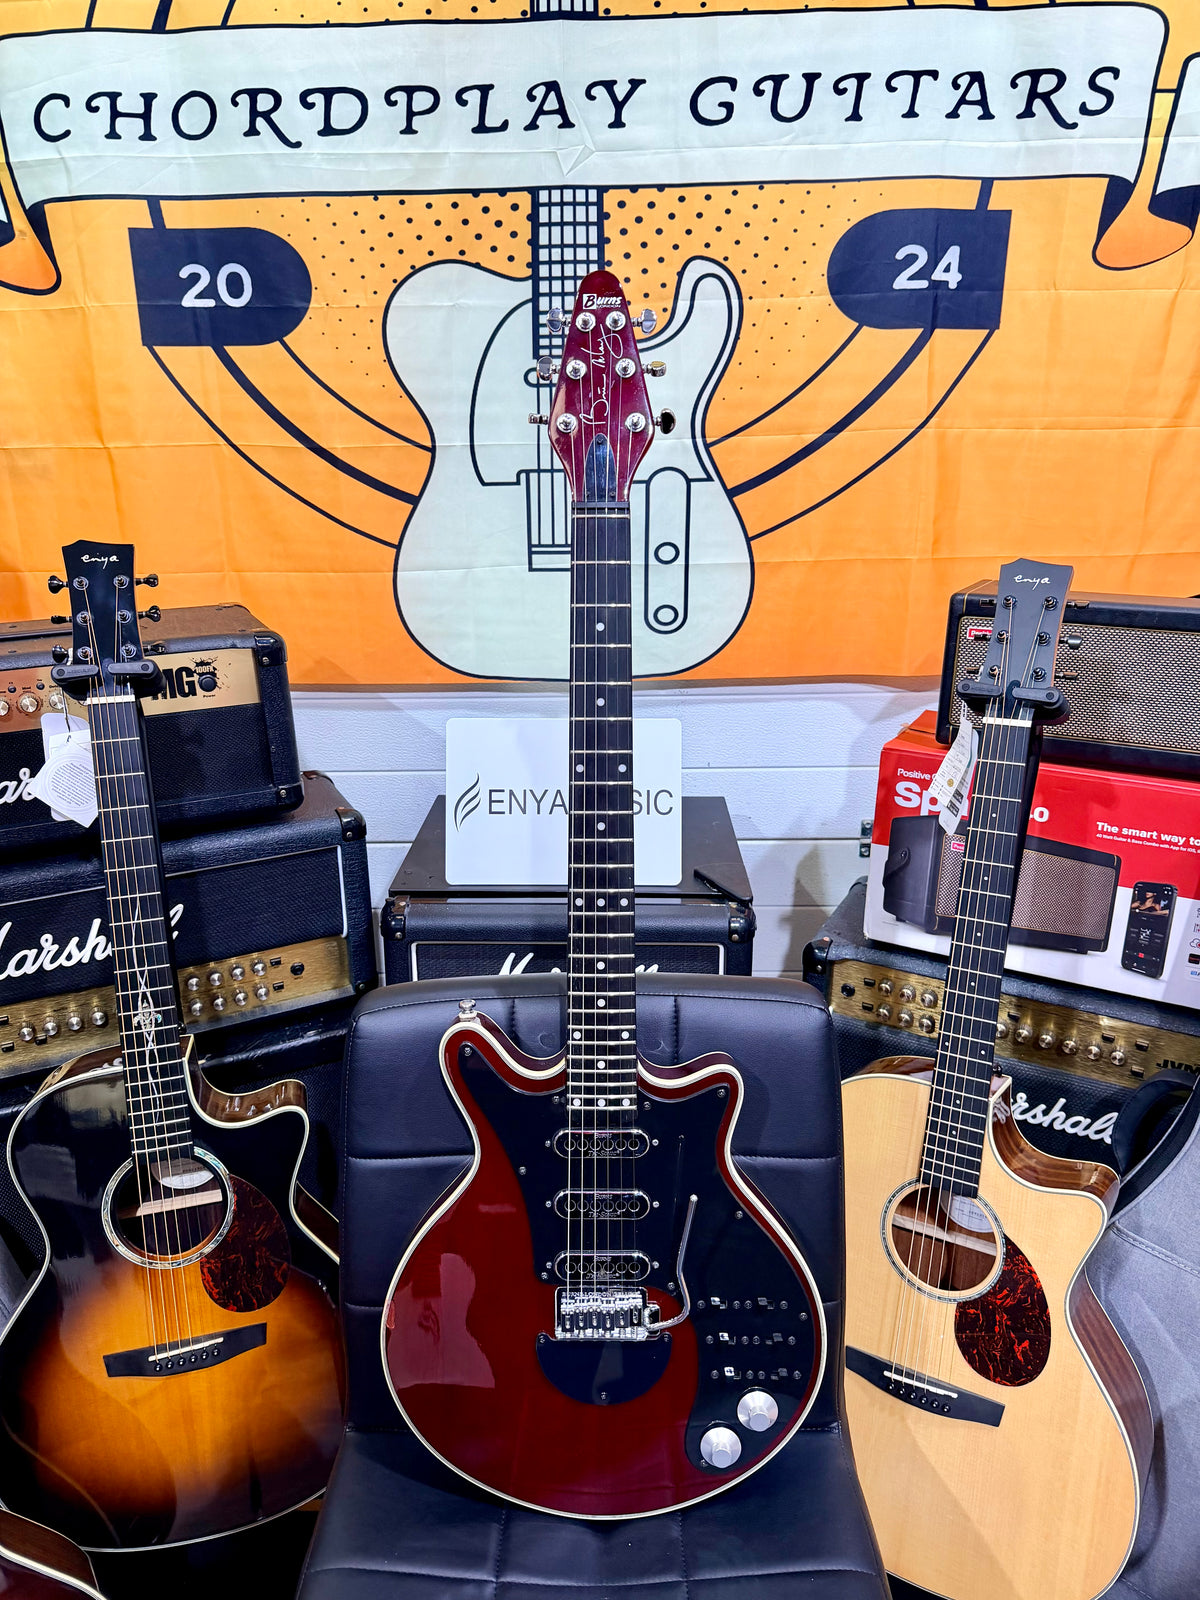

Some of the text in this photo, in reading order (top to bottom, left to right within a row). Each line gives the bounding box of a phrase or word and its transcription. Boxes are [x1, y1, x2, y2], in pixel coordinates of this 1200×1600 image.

[33, 65, 1121, 148] CHORDPLAY GUITARS
[892, 243, 963, 290] 24
[178, 262, 253, 308] 20
[583, 294, 622, 309] Burns
[80, 554, 120, 570] enya
[1013, 574, 1051, 591] enya
[897, 767, 931, 780] Positive
[487, 788, 674, 816] ENYA SIC
[1096, 821, 1200, 847] The smart way to
[1011, 1092, 1119, 1145] rshal
